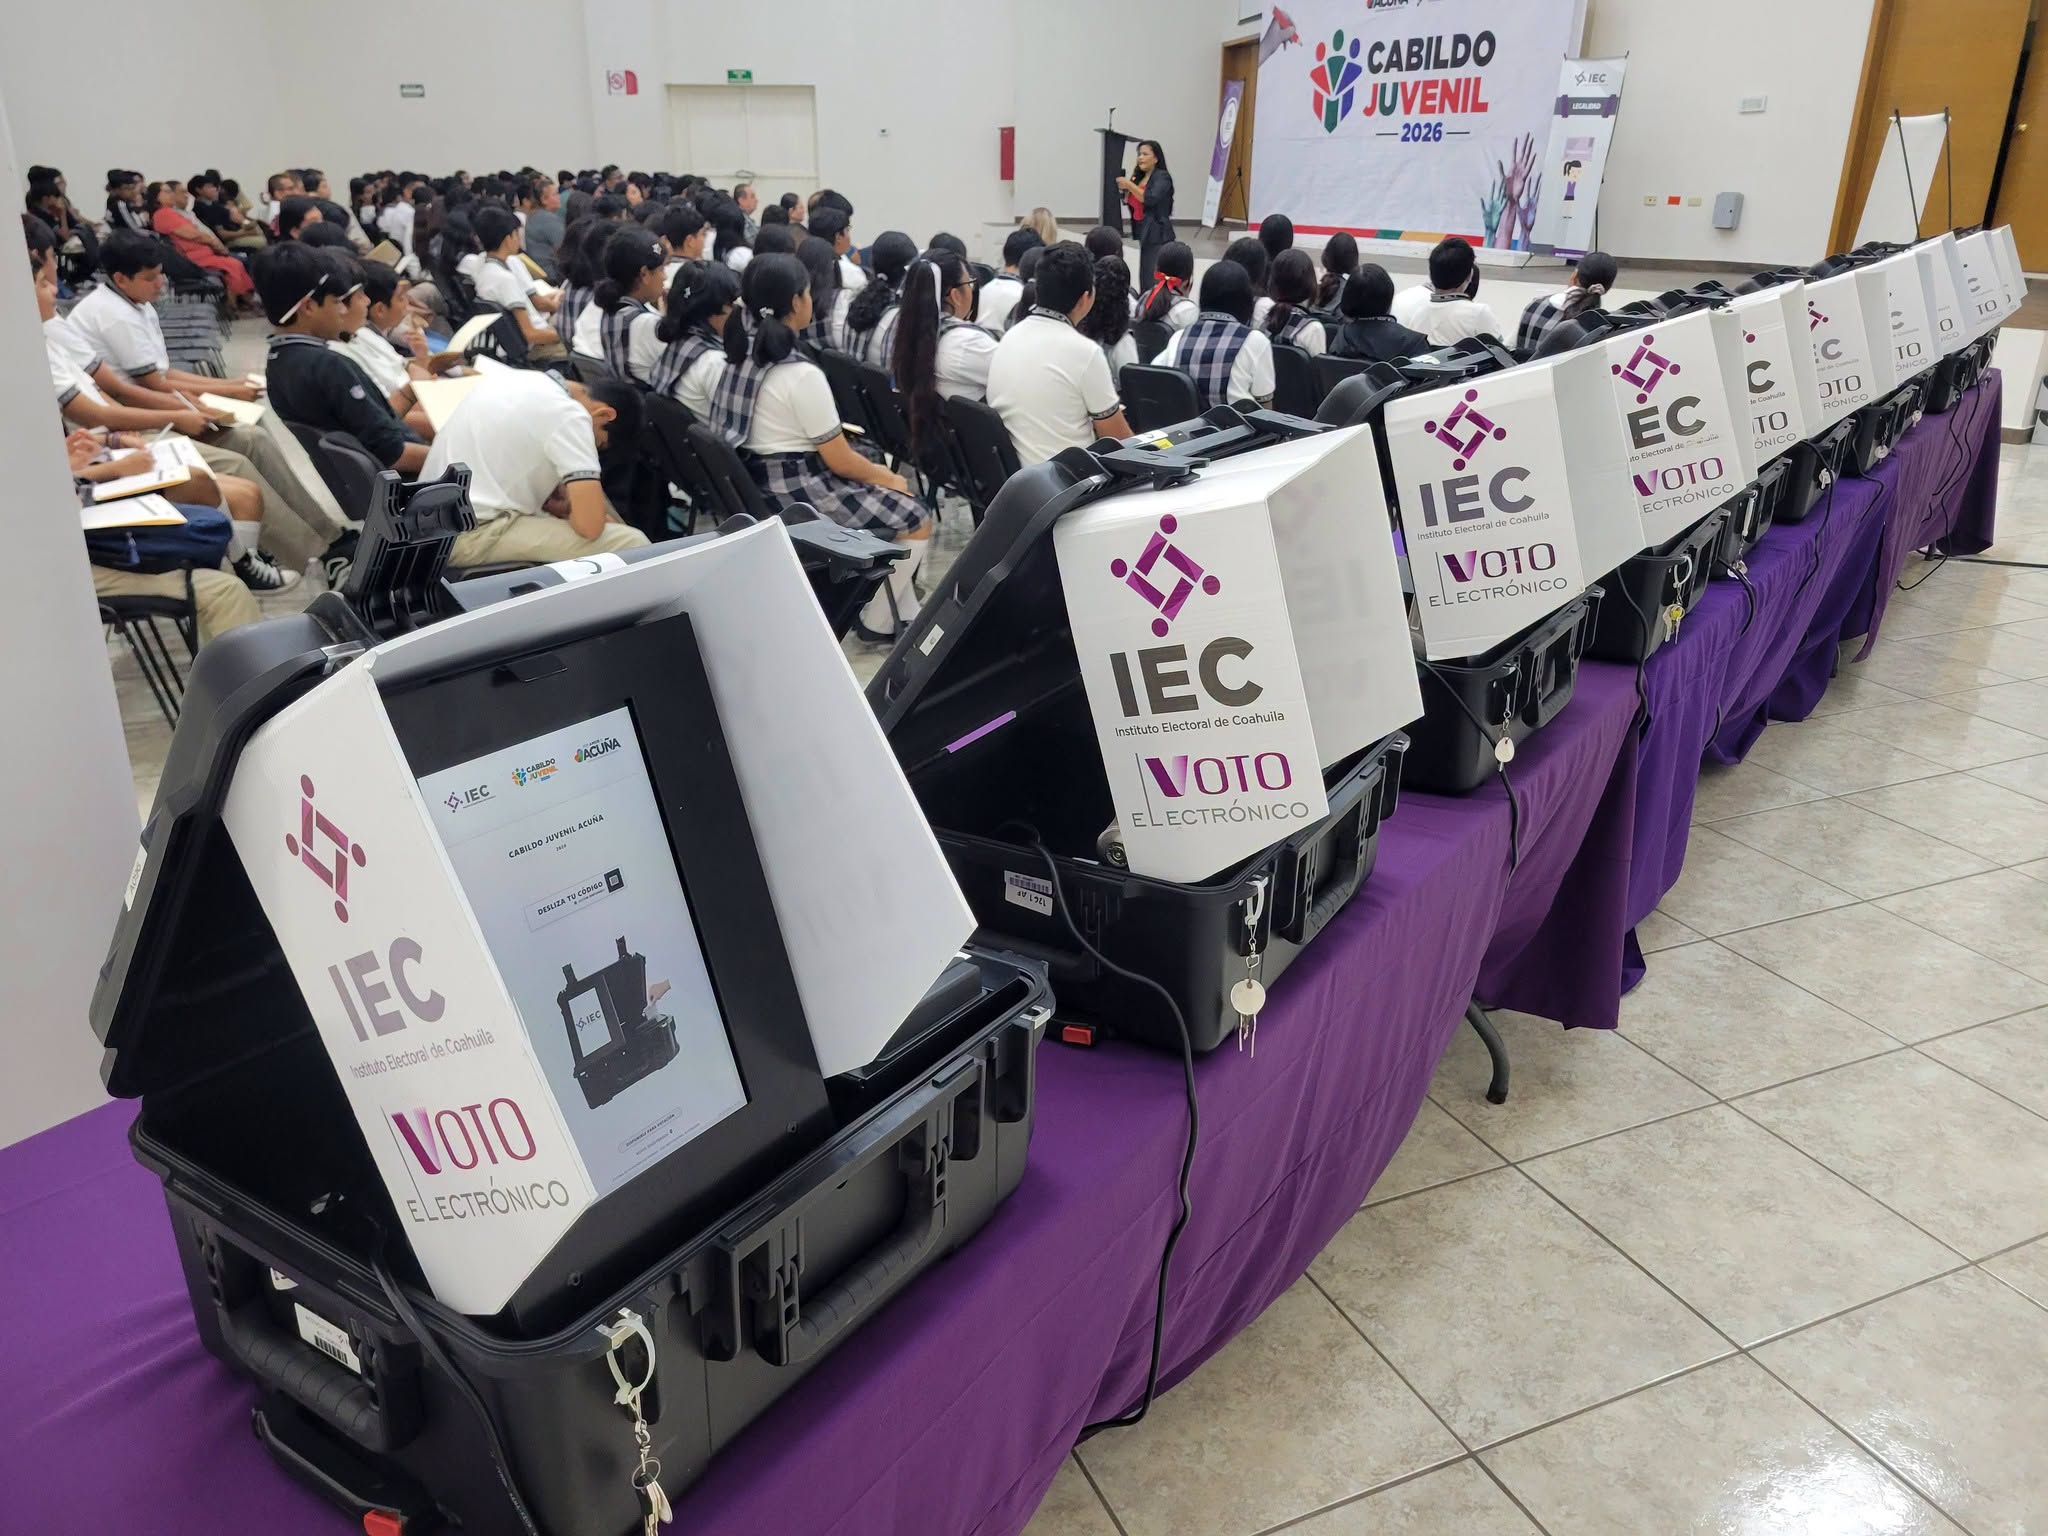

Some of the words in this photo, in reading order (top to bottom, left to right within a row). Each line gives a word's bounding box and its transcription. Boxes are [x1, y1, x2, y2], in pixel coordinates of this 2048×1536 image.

[1367, 30, 1496, 75] CABILDO
[1588, 73, 1607, 83] IEC
[1363, 77, 1489, 117] JUVENIL
[1400, 122, 1443, 142] 2026
[1976, 300, 1997, 315] TO
[1895, 342, 1921, 360] TO
[1819, 375, 1862, 399] OTO
[1823, 393, 1869, 410] RÓNICO
[1626, 395, 1707, 450] EC
[1752, 411, 1788, 434] TO
[1641, 445, 1674, 459] Electoral
[1632, 457, 1724, 497] VOTO
[1419, 466, 1536, 527] IEC
[1642, 483, 1734, 514] ECTRÓNICO
[1417, 528, 1453, 541] Instituto
[1454, 521, 1494, 534] Electoral
[1495, 519, 1507, 528] de
[1509, 512, 1550, 525] Coahuila
[1443, 543, 1556, 583] VOTO
[1429, 578, 1568, 608] ELECTRÓNICO
[1109, 636, 1264, 718] IEC
[1115, 724, 1160, 737] Instituto
[1162, 717, 1212, 733] Electoral
[1214, 716, 1230, 727] de
[1232, 711, 1285, 726] Coahuila
[526, 758, 556, 773] CABILDO
[1144, 752, 1292, 798] VOTO
[464, 784, 490, 804] IEC
[1131, 799, 1309, 828] ELECTRÓNICO
[508, 839, 543, 858] CABILDO
[545, 825, 577, 844] JUVENIL
[578, 814, 604, 831] ACUÑA
[537, 898, 567, 916] DESLIZA
[566, 893, 577, 902] TU
[577, 881, 604, 897] CÓDIGO
[328, 936, 446, 1042] IEC
[585, 1010, 602, 1024] IEC
[350, 1058, 387, 1079] Instituto
[386, 1044, 429, 1071] Electoral
[430, 1042, 446, 1059] de
[445, 1028, 495, 1056] Coahuila
[390, 1097, 537, 1175] VOTO
[406, 1176, 570, 1223] ELECTRÓNICO
